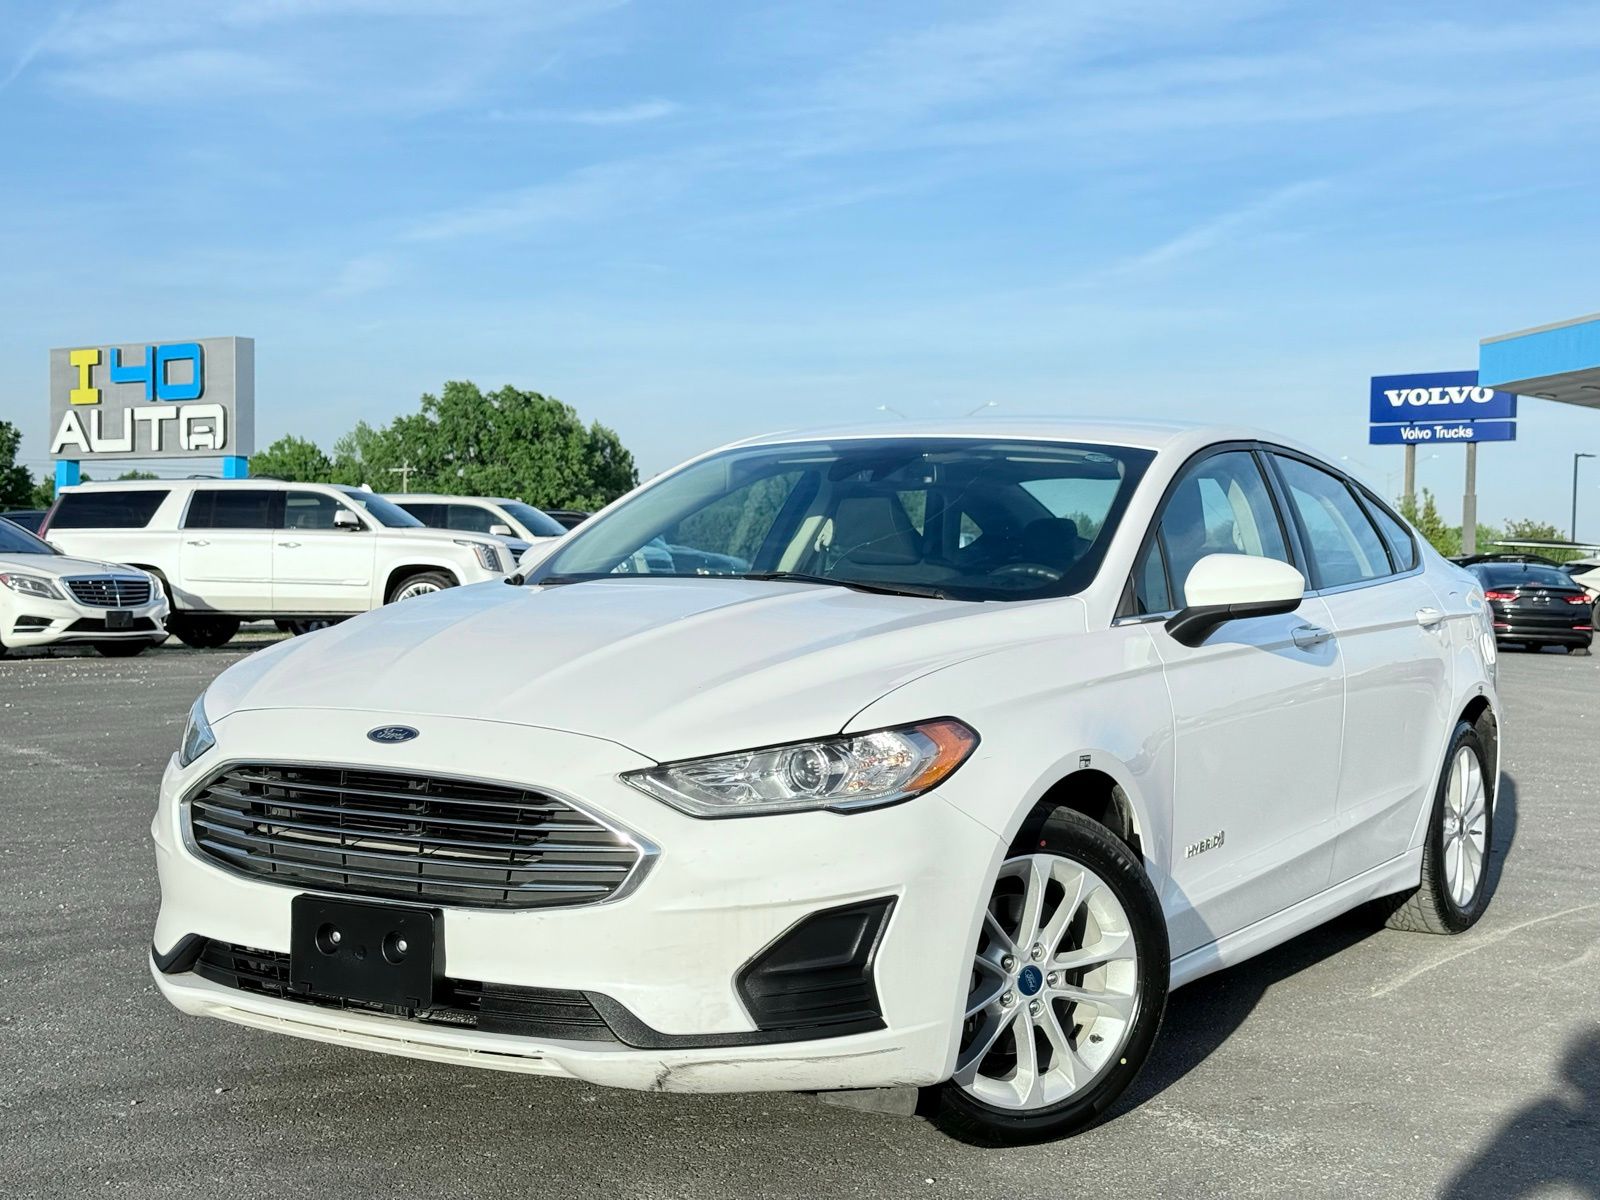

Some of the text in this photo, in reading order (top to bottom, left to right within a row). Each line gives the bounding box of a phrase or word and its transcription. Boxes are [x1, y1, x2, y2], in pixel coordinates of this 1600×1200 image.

[1384, 386, 1494, 407] VOLVO
[1401, 425, 1474, 440] Volvo Trucks
[377, 728, 408, 739] Ford
[1185, 836, 1220, 858] HYBRID
